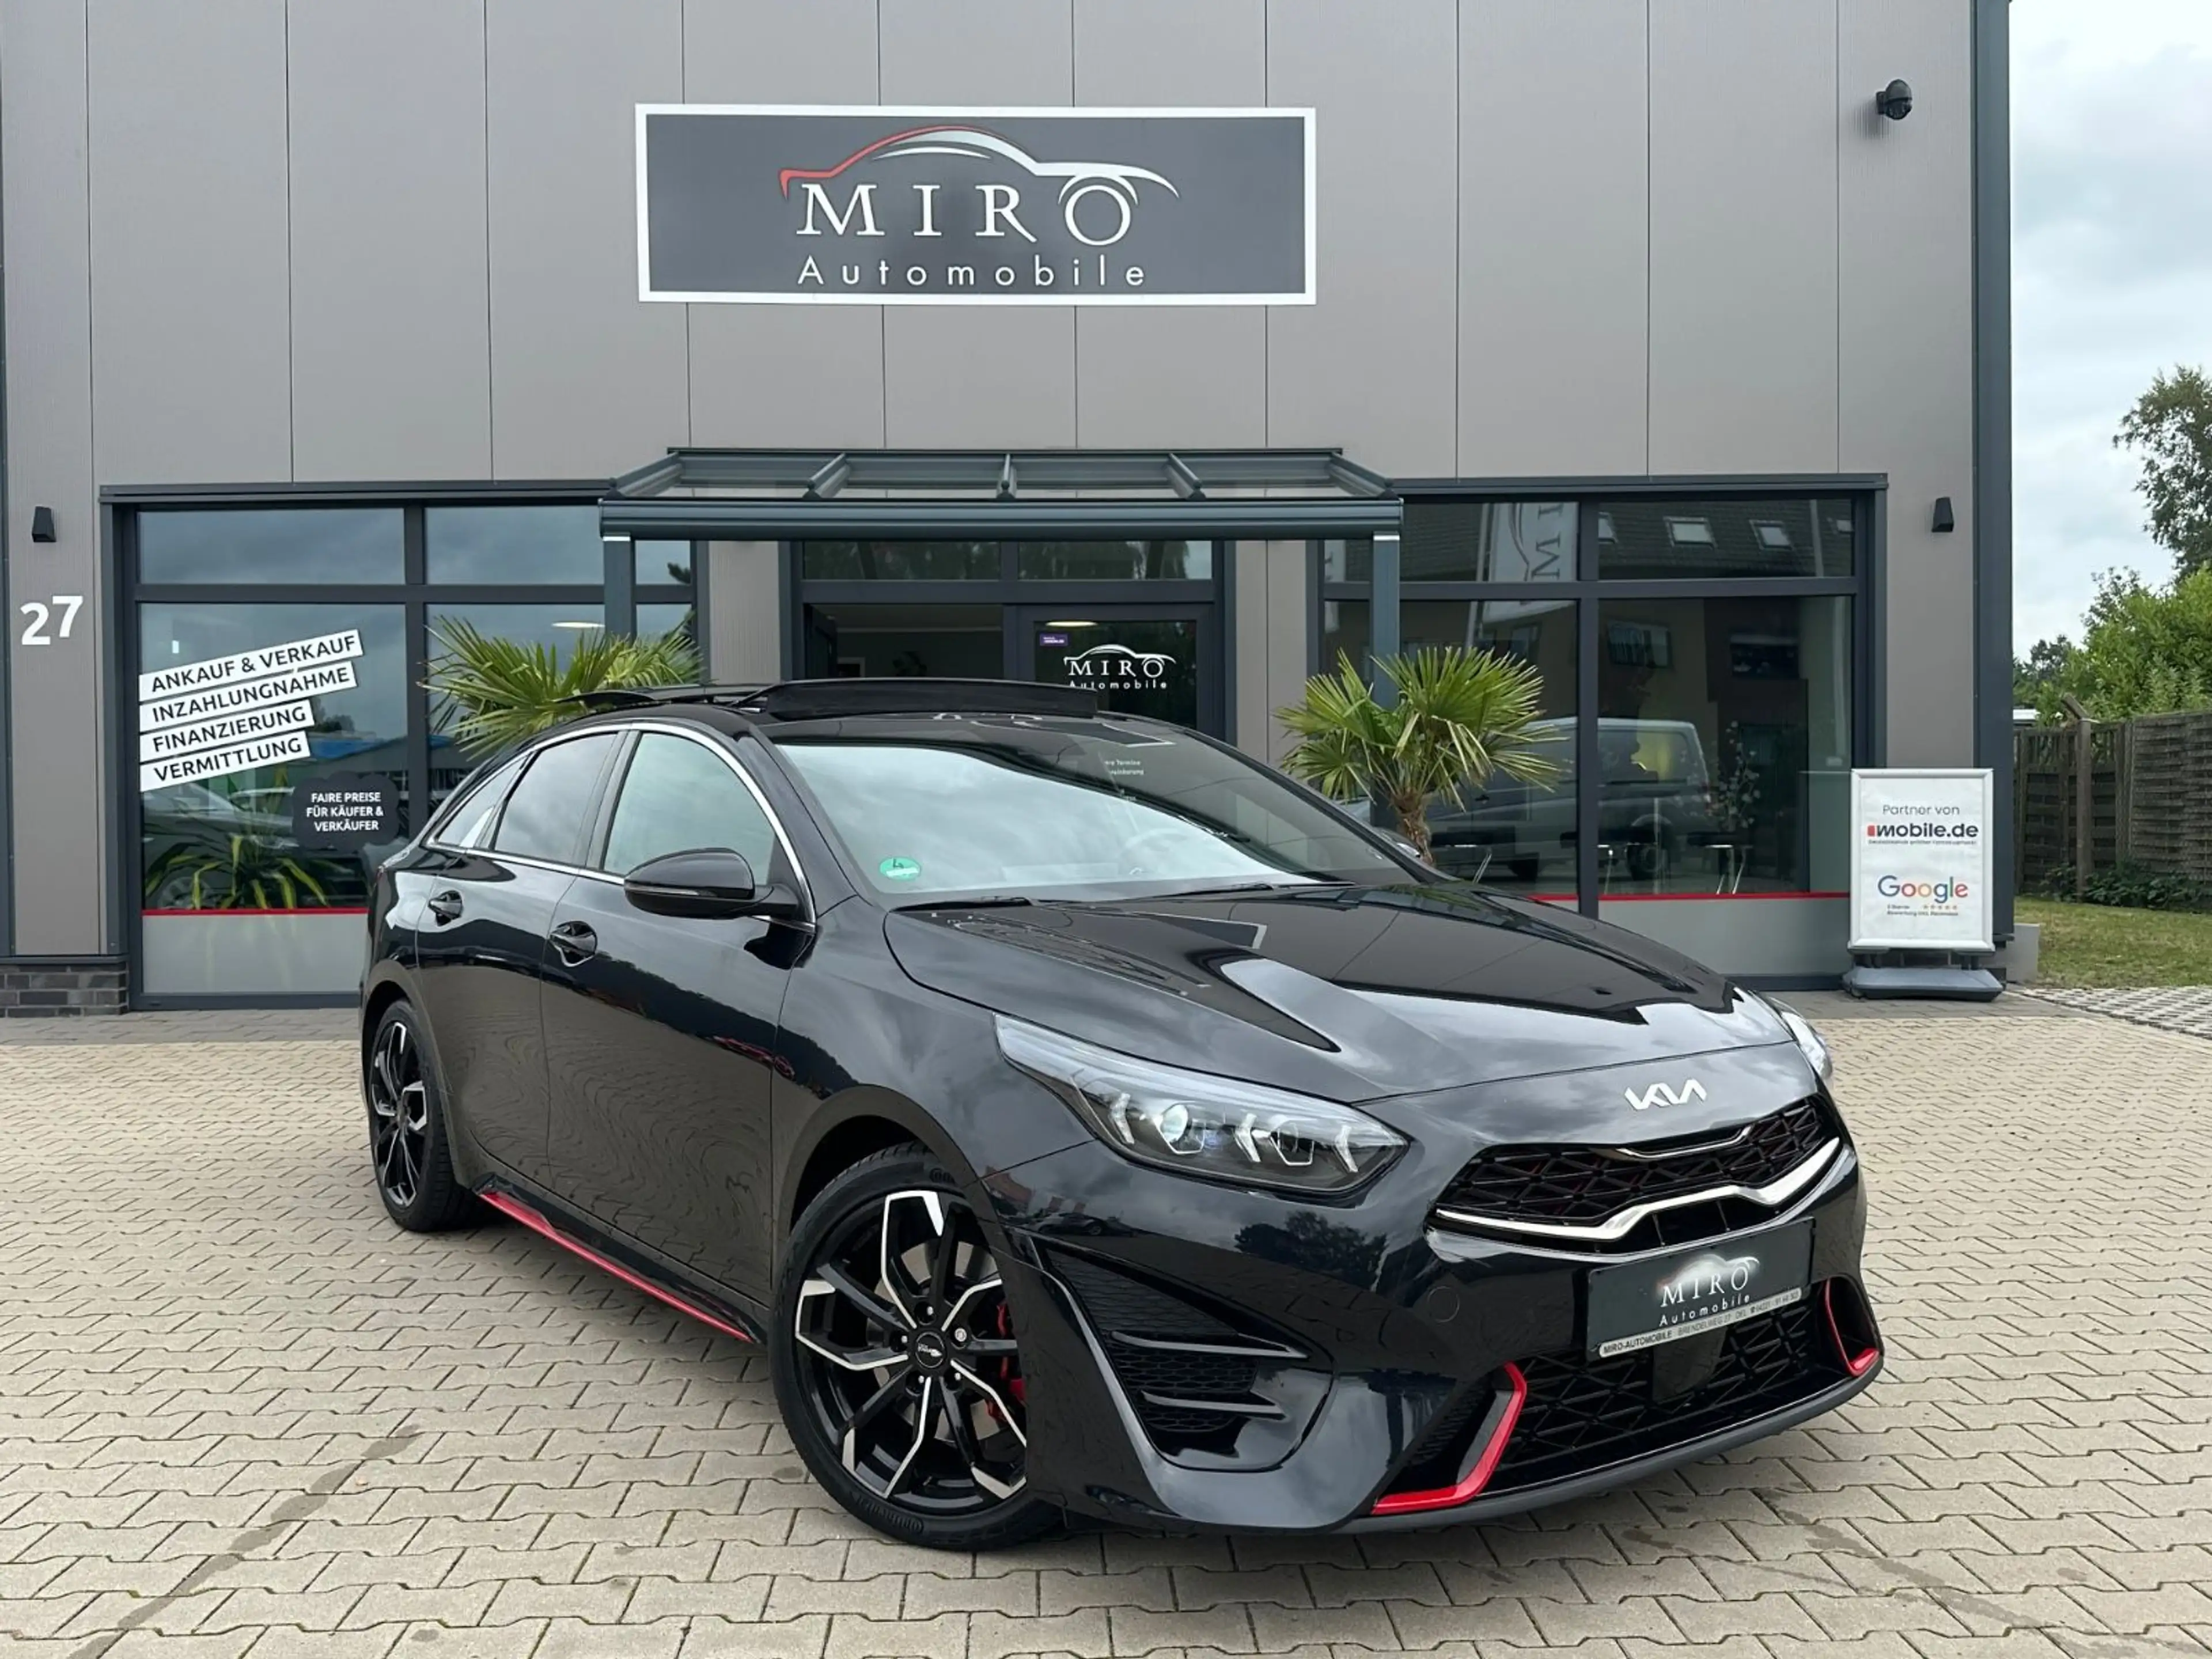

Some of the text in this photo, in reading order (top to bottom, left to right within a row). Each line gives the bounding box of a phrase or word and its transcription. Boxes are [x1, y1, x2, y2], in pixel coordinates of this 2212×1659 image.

[796, 183, 1131, 245] MIRO
[797, 254, 1145, 286] Automobile
[20, 596, 84, 646] 27
[151, 635, 355, 692] ANKAUF & VERKAUF
[1068, 660, 1164, 678] MIRO
[152, 667, 350, 722] INZAHLUNGNAHME
[1069, 680, 1167, 690] Automobile
[153, 706, 306, 752] FINANZIERUNG
[154, 737, 302, 782] VERMITTLUNG
[306, 804, 384, 817] FÜR KÄUFER &
[311, 791, 381, 803] FAIRE PREISE
[1883, 804, 1961, 816] Partner von
[313, 819, 379, 832] VERKÄUFER
[1876, 822, 1979, 838] mobile.de
[1877, 874, 1969, 904] Google
[1624, 1078, 1709, 1111] KIA
[1660, 1266, 1749, 1308] MIRO
[1658, 1293, 1751, 1327] Automobile
